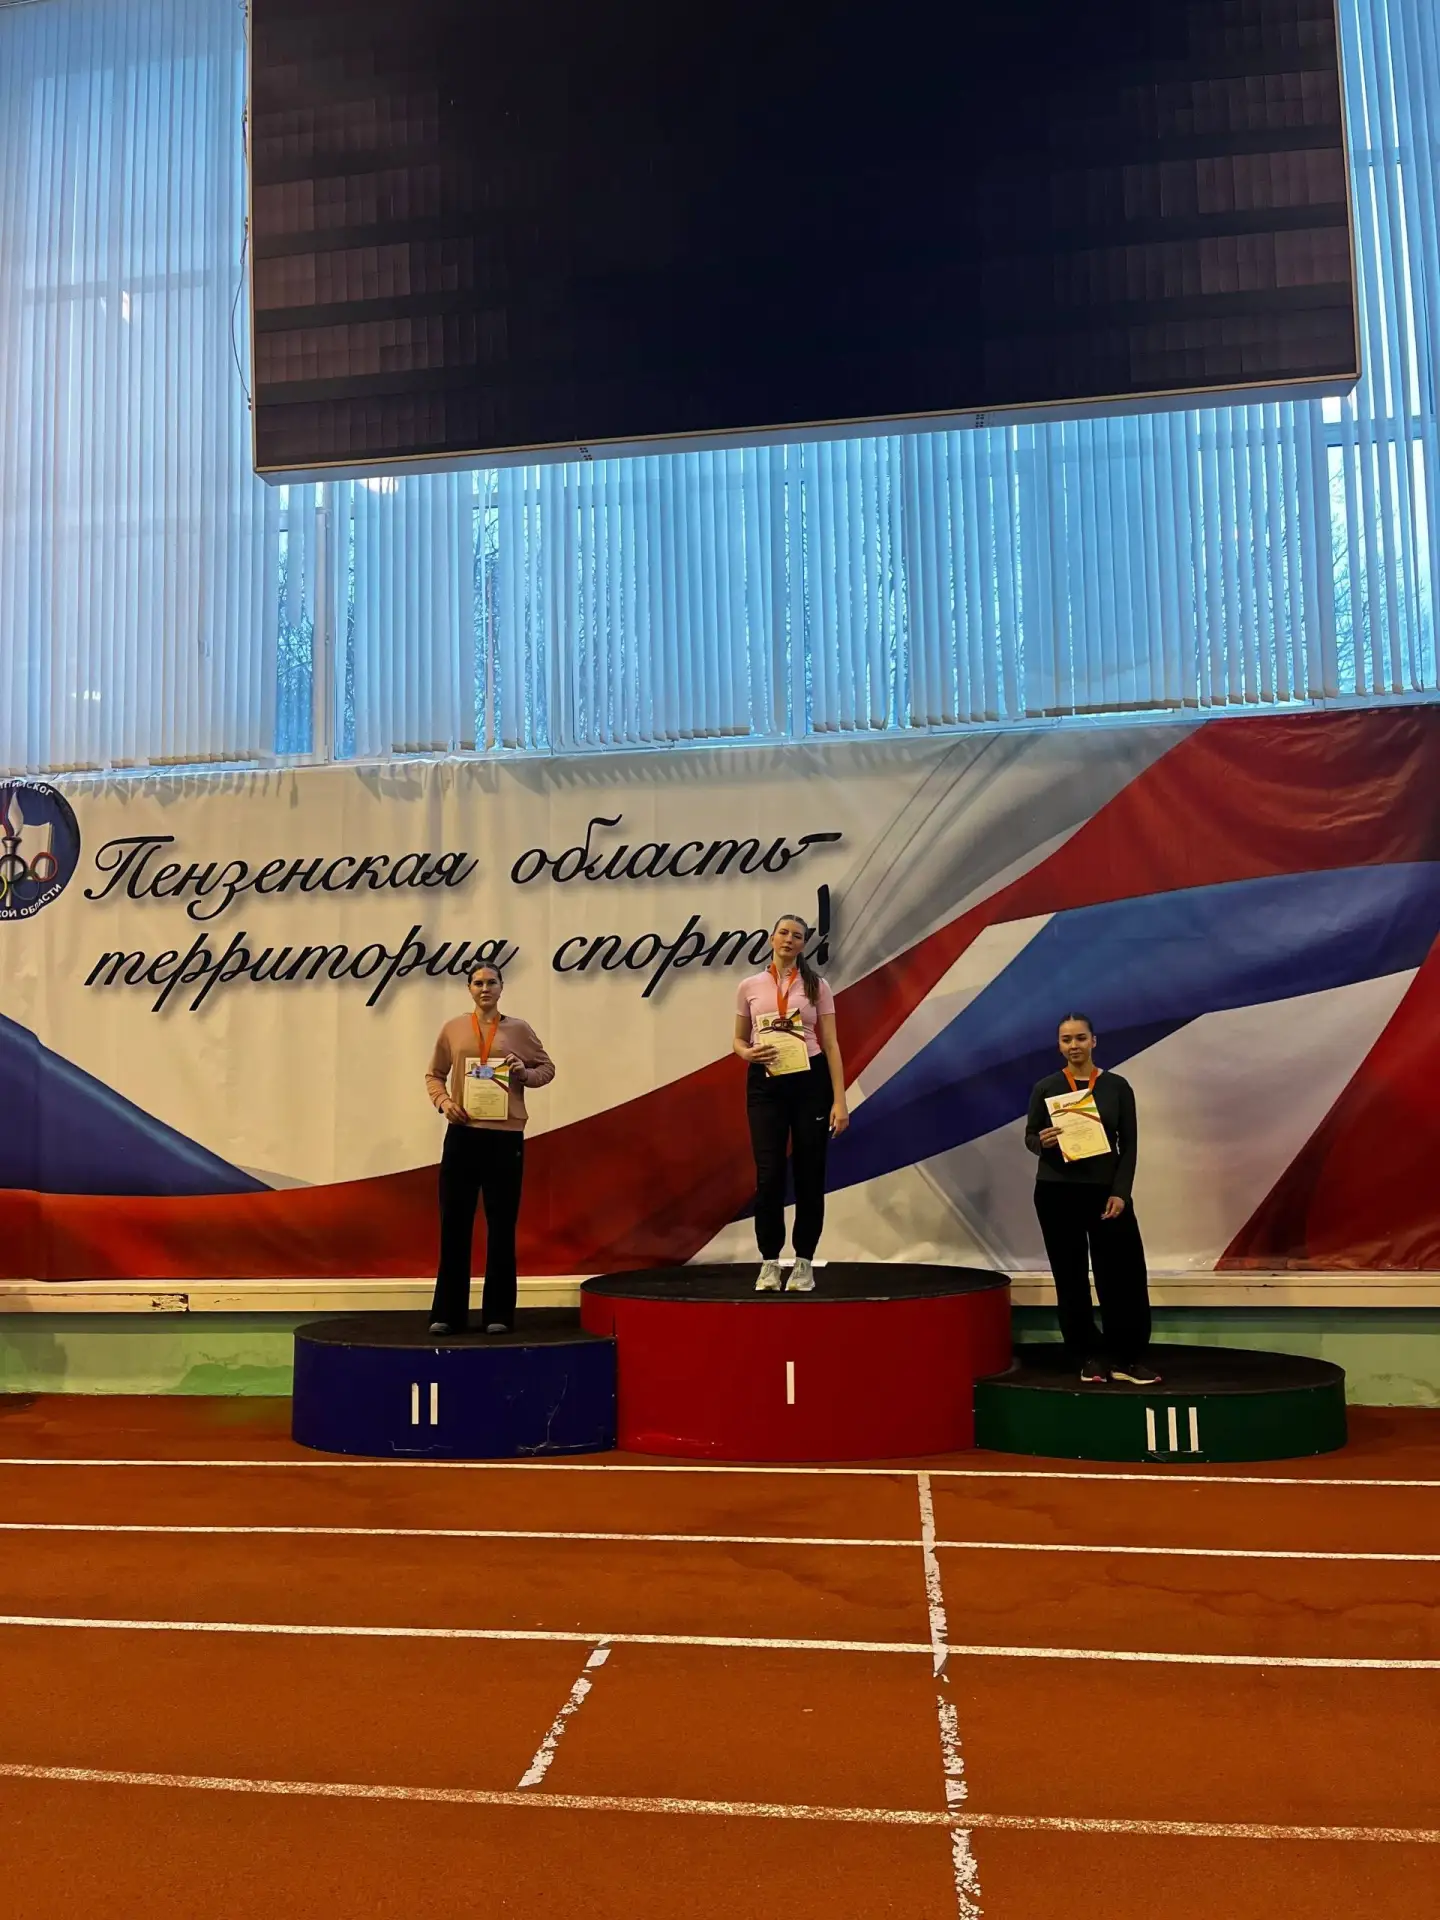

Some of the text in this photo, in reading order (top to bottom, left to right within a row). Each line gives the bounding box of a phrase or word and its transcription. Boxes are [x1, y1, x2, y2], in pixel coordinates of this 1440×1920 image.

[20, 883, 62, 916] ОБЛАСТИ
[84, 835, 479, 921] Пензенская
[83, 884, 831, 1013] территория спорт!
